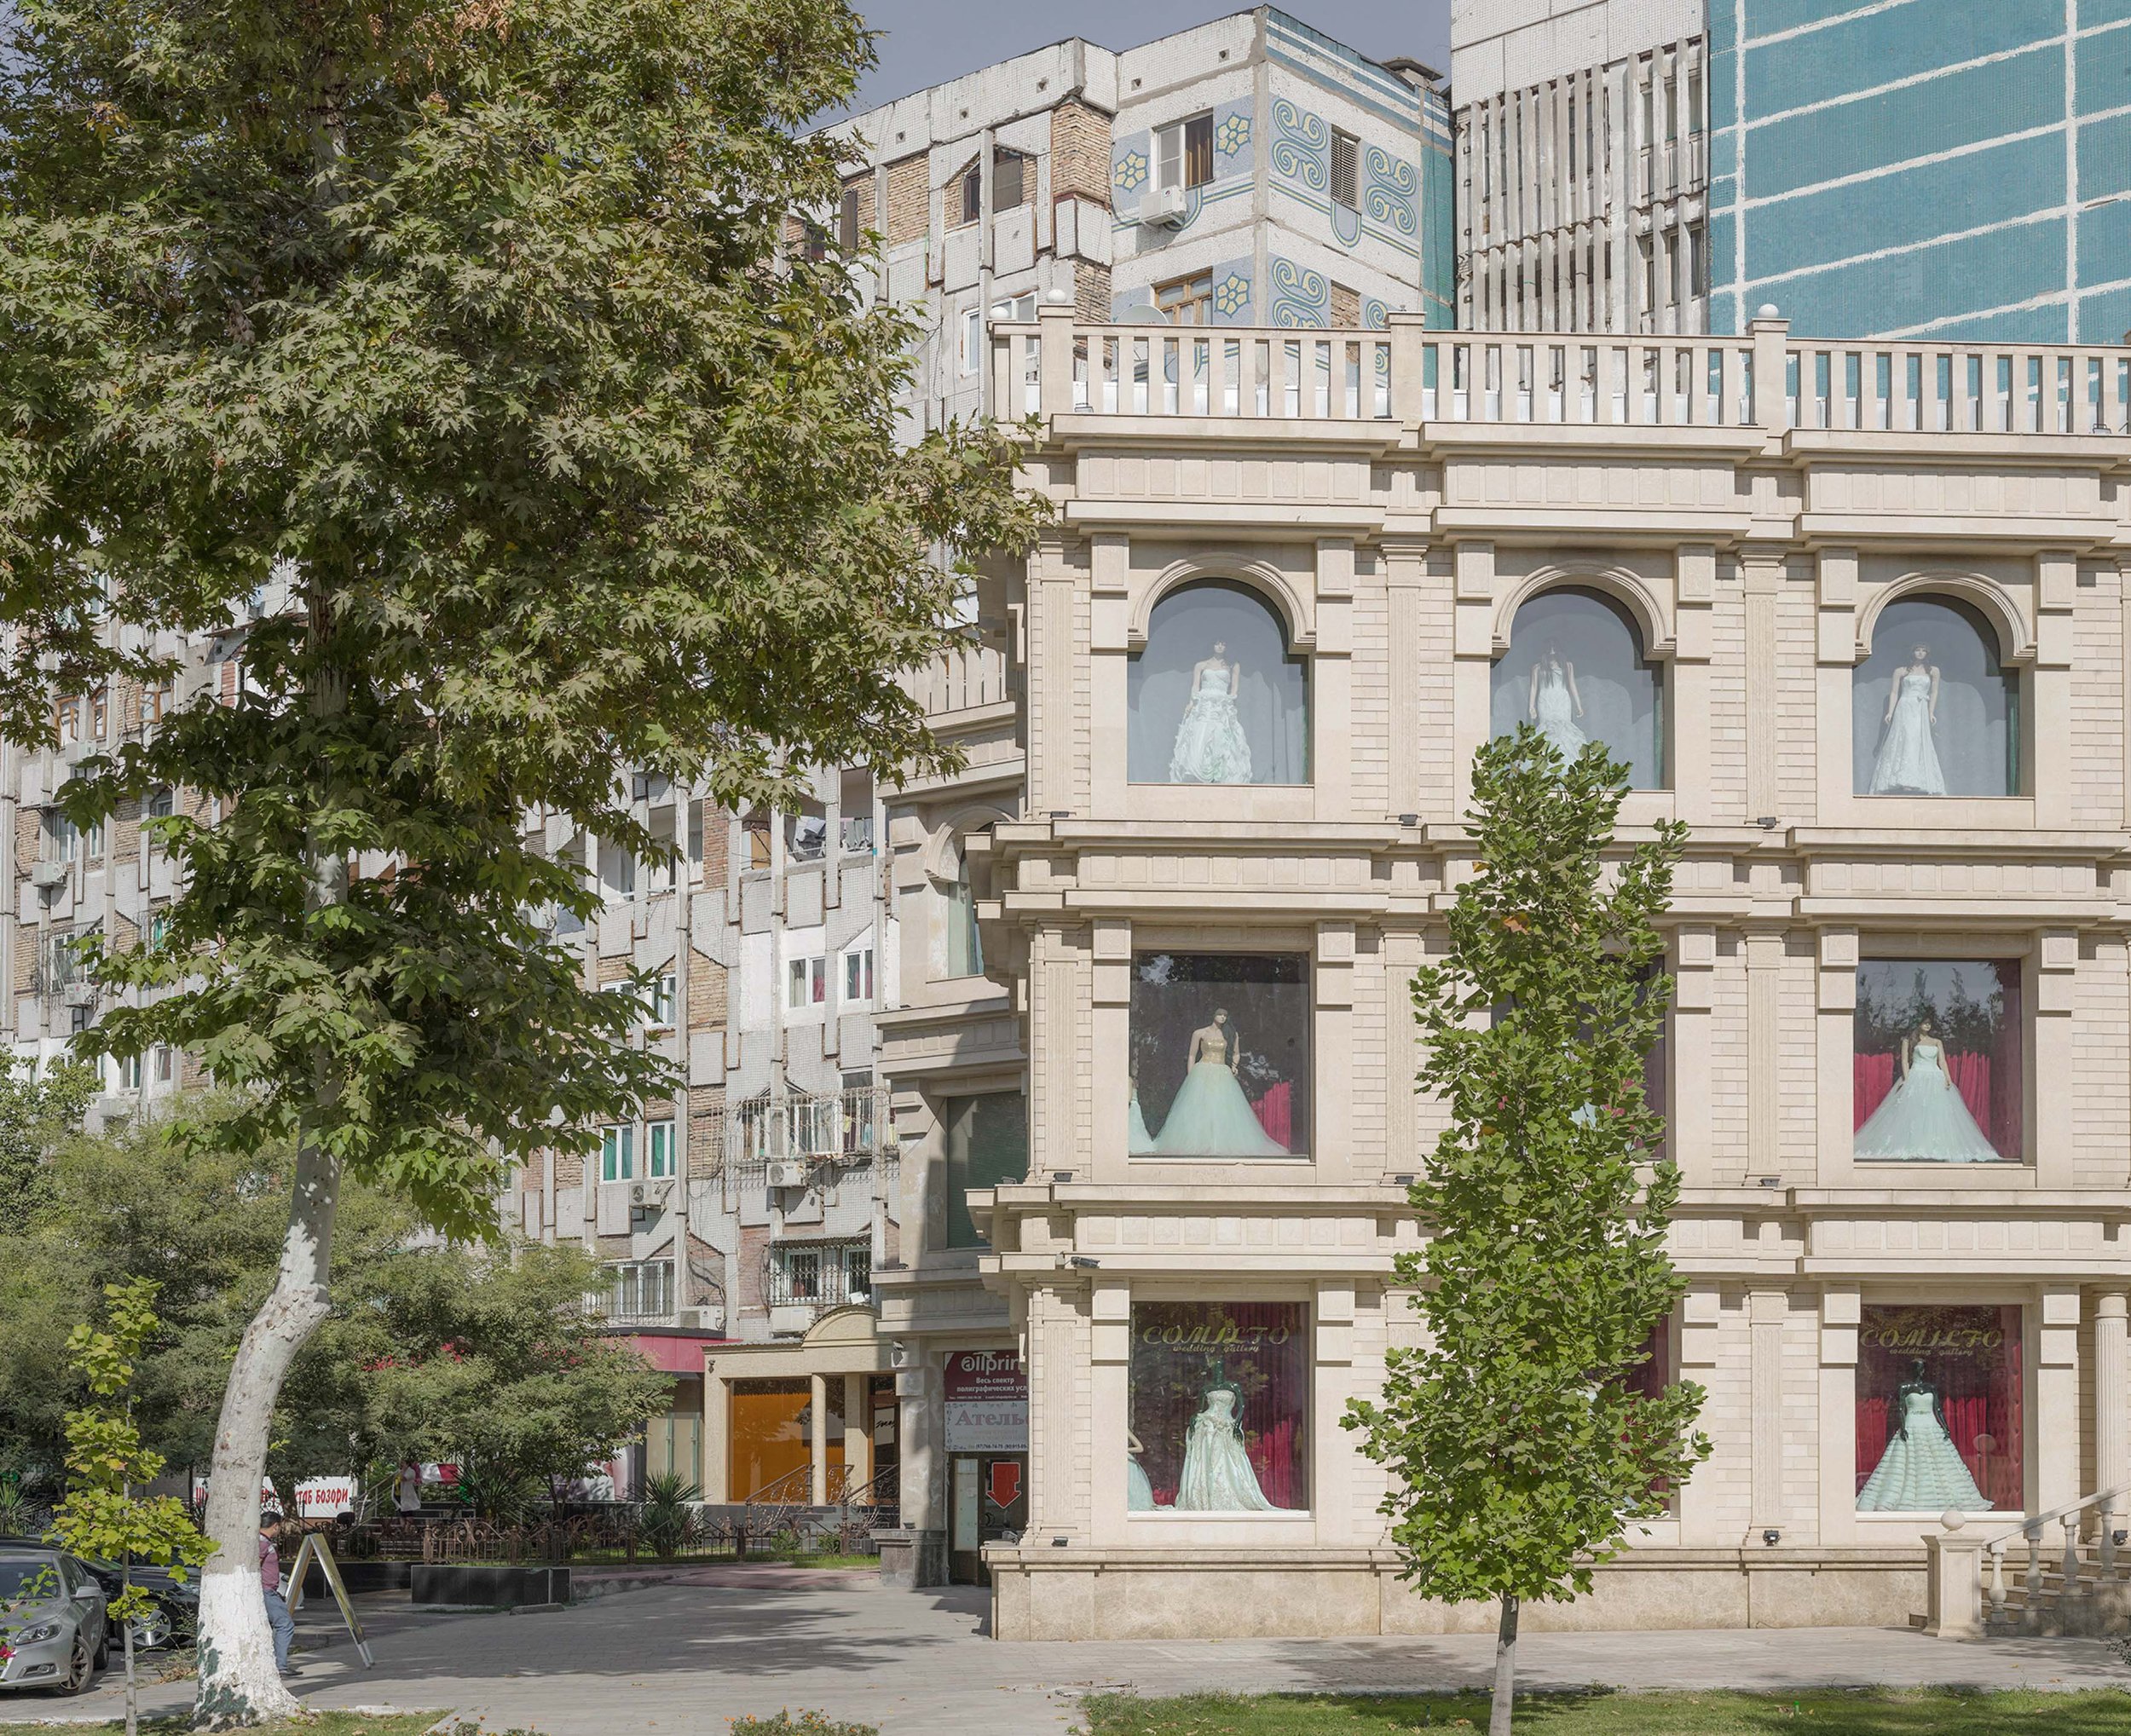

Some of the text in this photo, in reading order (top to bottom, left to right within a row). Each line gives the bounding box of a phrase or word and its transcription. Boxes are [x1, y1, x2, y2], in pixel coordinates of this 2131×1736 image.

[1860, 1329, 2002, 1348] COMILFO
[1223, 1344, 1260, 1353] gallery
[956, 1385, 1014, 1393] полиграфических
[315, 1487, 349, 1509] бозори
